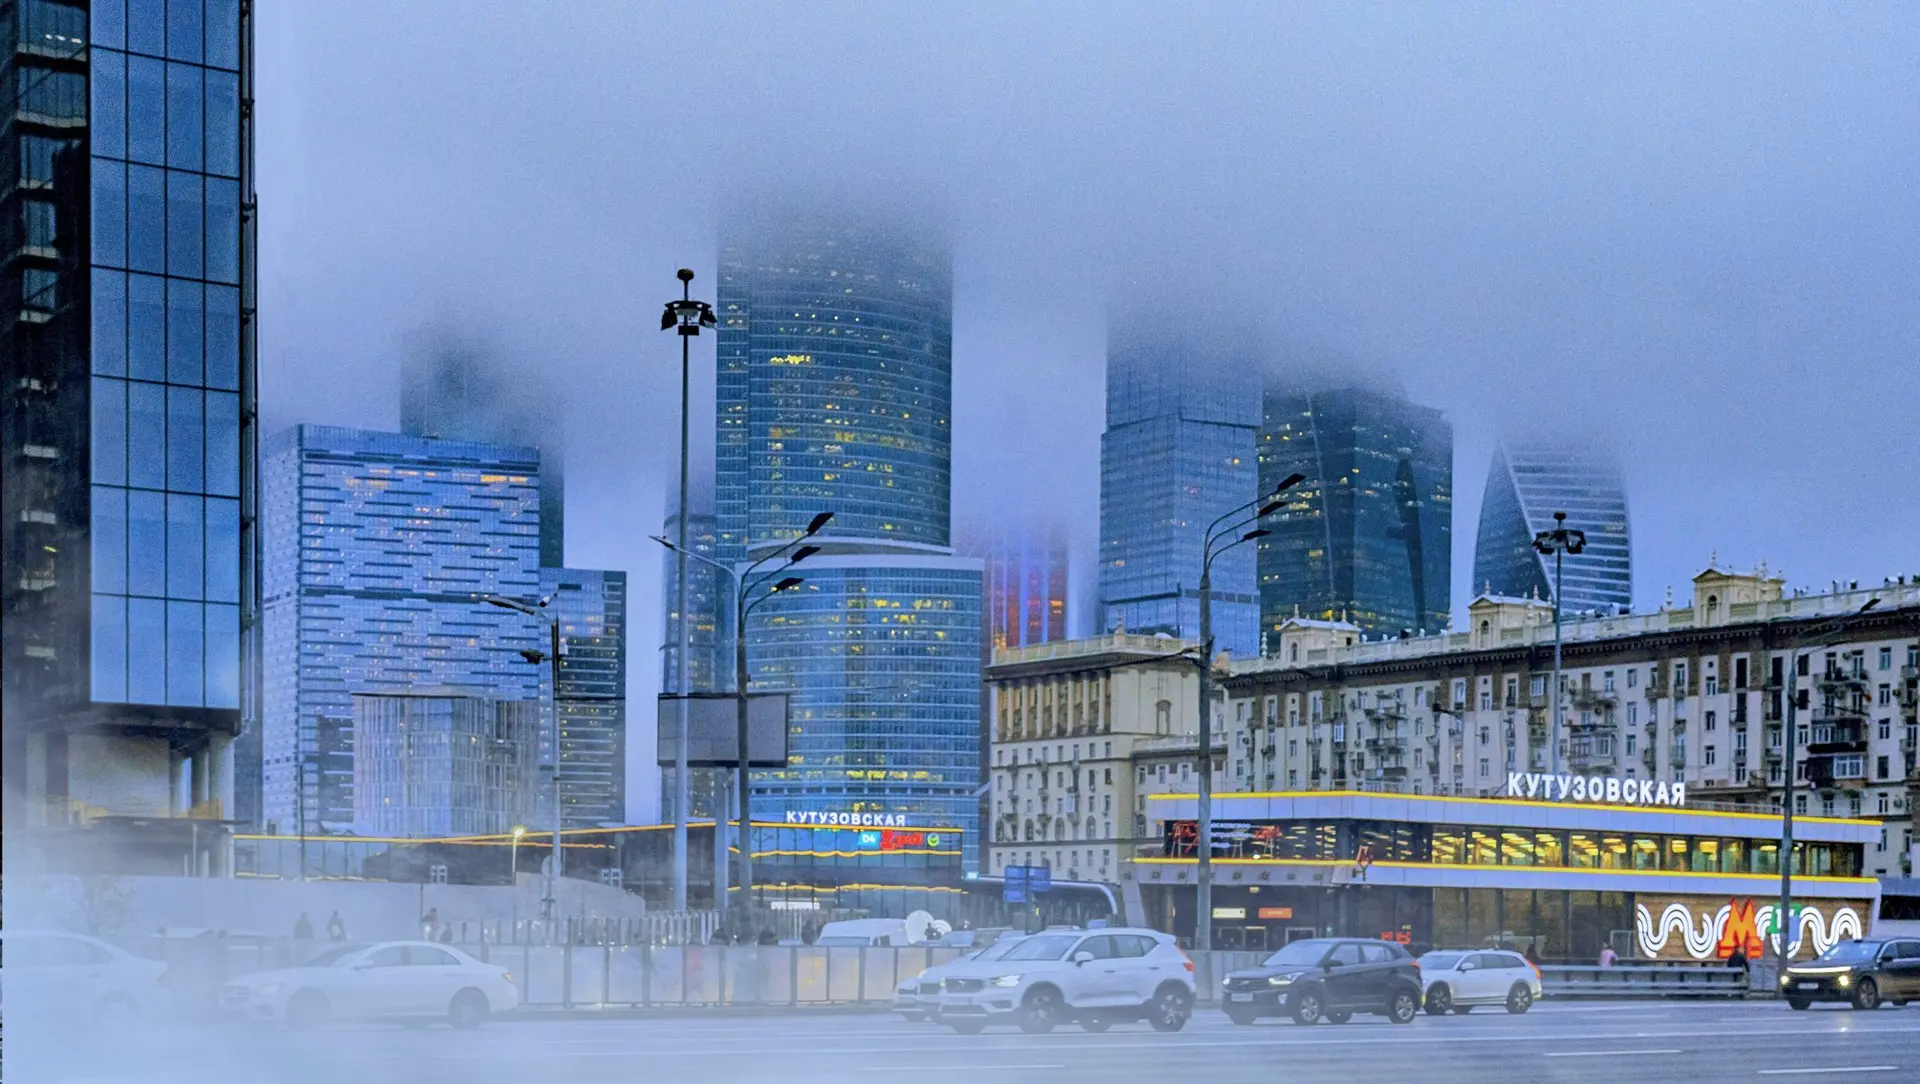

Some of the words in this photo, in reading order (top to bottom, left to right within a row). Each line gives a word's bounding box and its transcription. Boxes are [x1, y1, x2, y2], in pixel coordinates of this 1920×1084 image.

[1507, 772, 1686, 805] КУТУЗОВСКАЯ
[786, 810, 906, 827] КУТУЗОВСКАЯ
[1718, 897, 1763, 958] М
